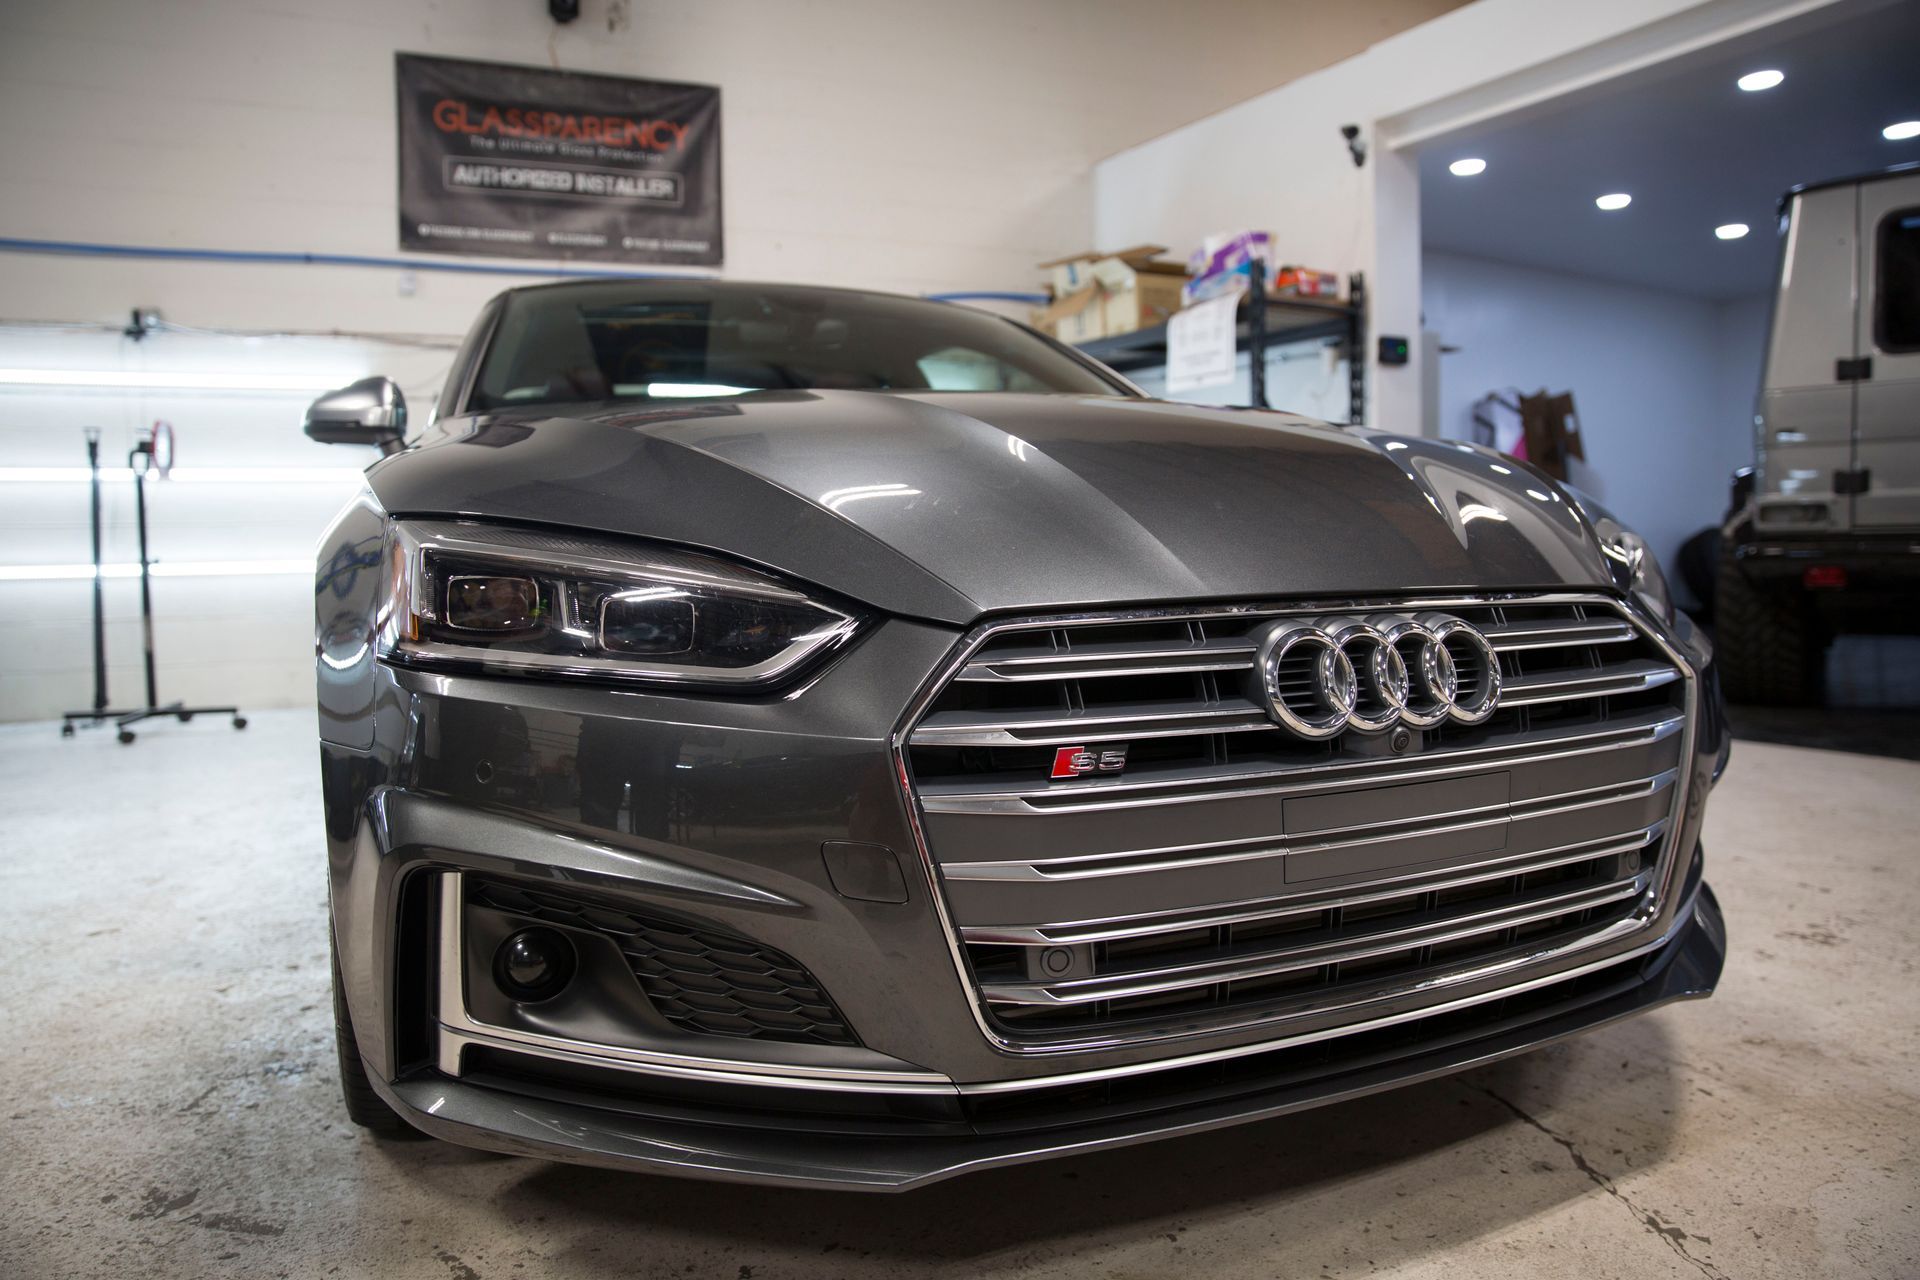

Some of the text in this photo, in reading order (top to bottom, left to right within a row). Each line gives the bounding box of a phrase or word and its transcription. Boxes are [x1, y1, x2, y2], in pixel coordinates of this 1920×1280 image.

[433, 99, 688, 151] GLASSPARENCY
[453, 164, 674, 198] AUTHORIZED INSTALLER
[1069, 751, 1126, 773] S5
